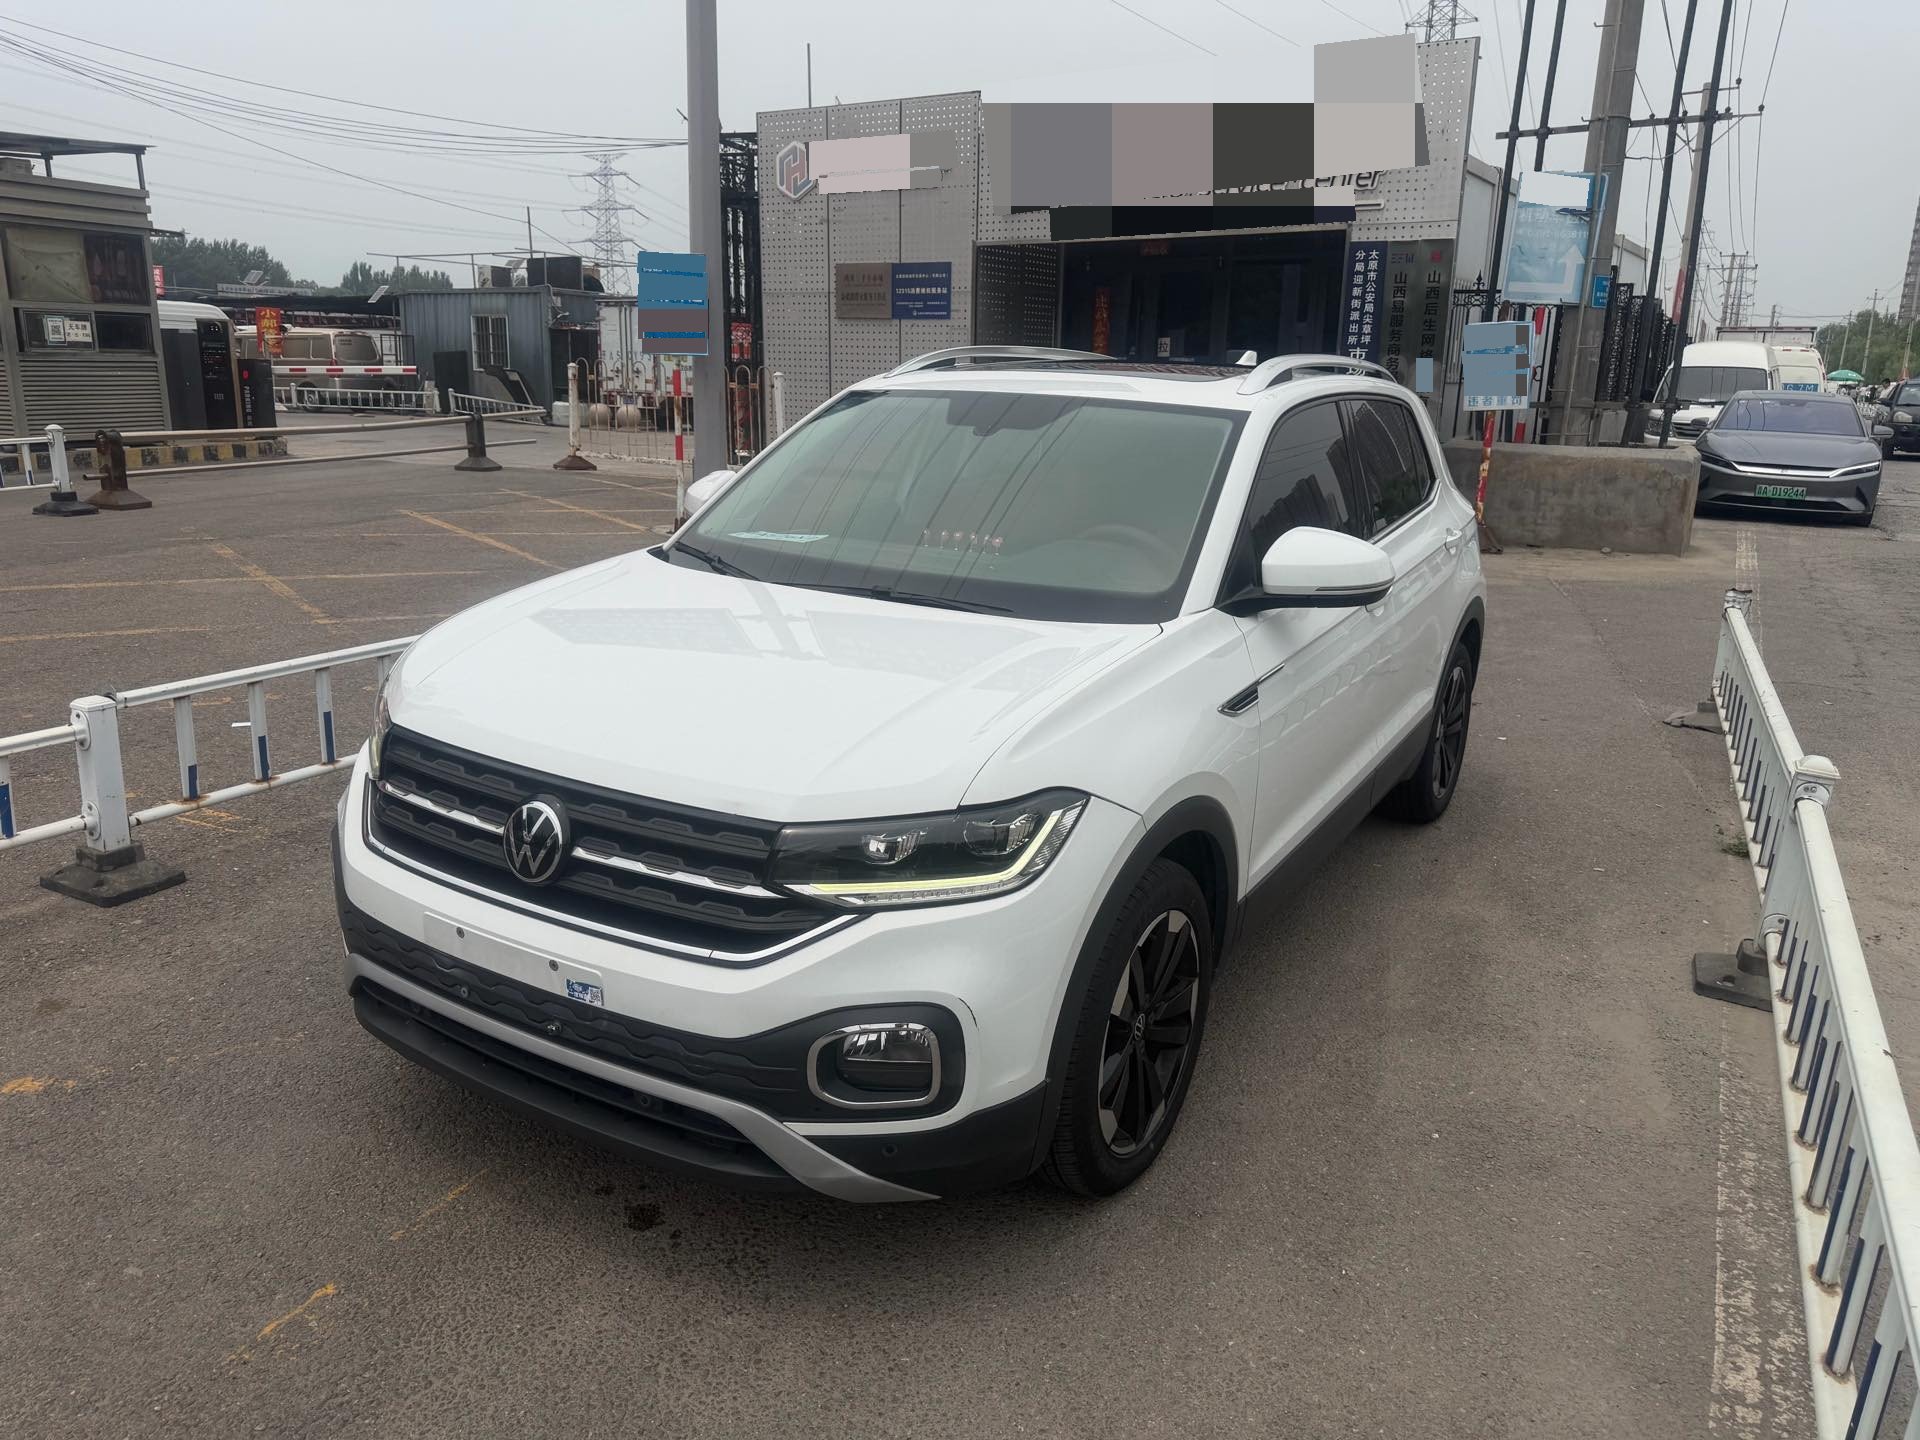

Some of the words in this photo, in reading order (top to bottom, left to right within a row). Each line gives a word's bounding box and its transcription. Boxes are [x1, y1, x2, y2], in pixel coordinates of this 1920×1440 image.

[1347, 249, 1366, 345] 分局迎新街派出所
[1360, 249, 1380, 345] 太原市公安局尖草坪
